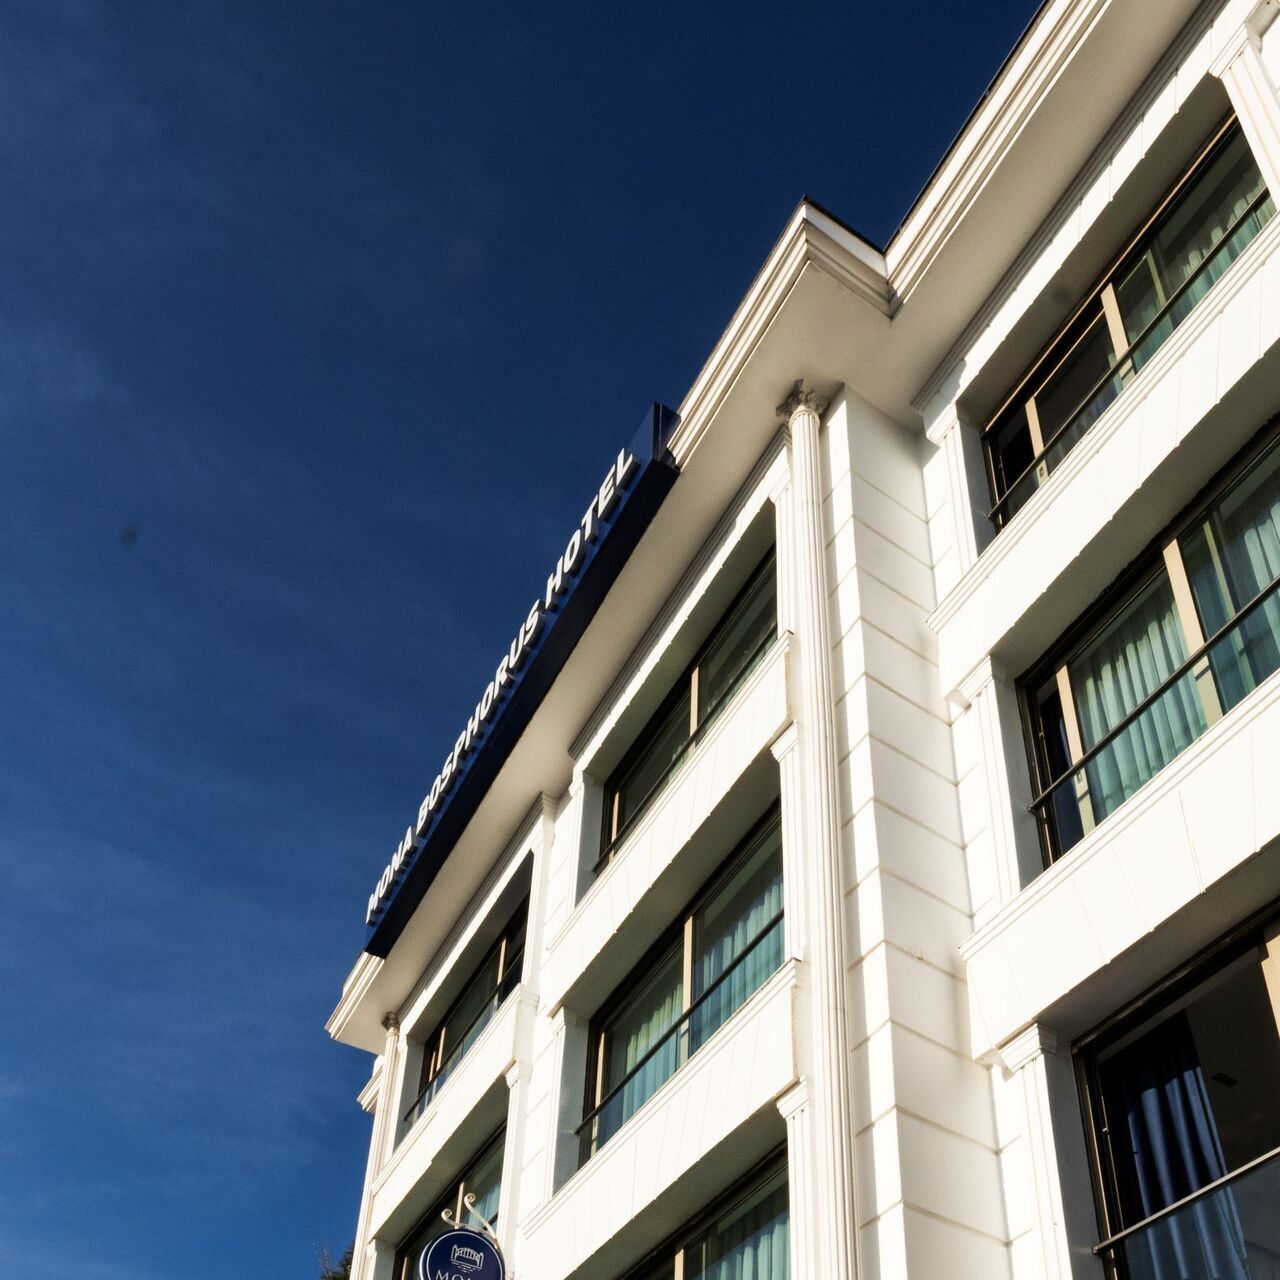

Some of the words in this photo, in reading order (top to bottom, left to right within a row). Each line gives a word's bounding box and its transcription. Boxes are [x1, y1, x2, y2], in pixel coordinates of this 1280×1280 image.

[366, 824, 417, 924] MONA
[416, 598, 543, 837] BOSPHORUS
[545, 448, 637, 611] HOTEL
